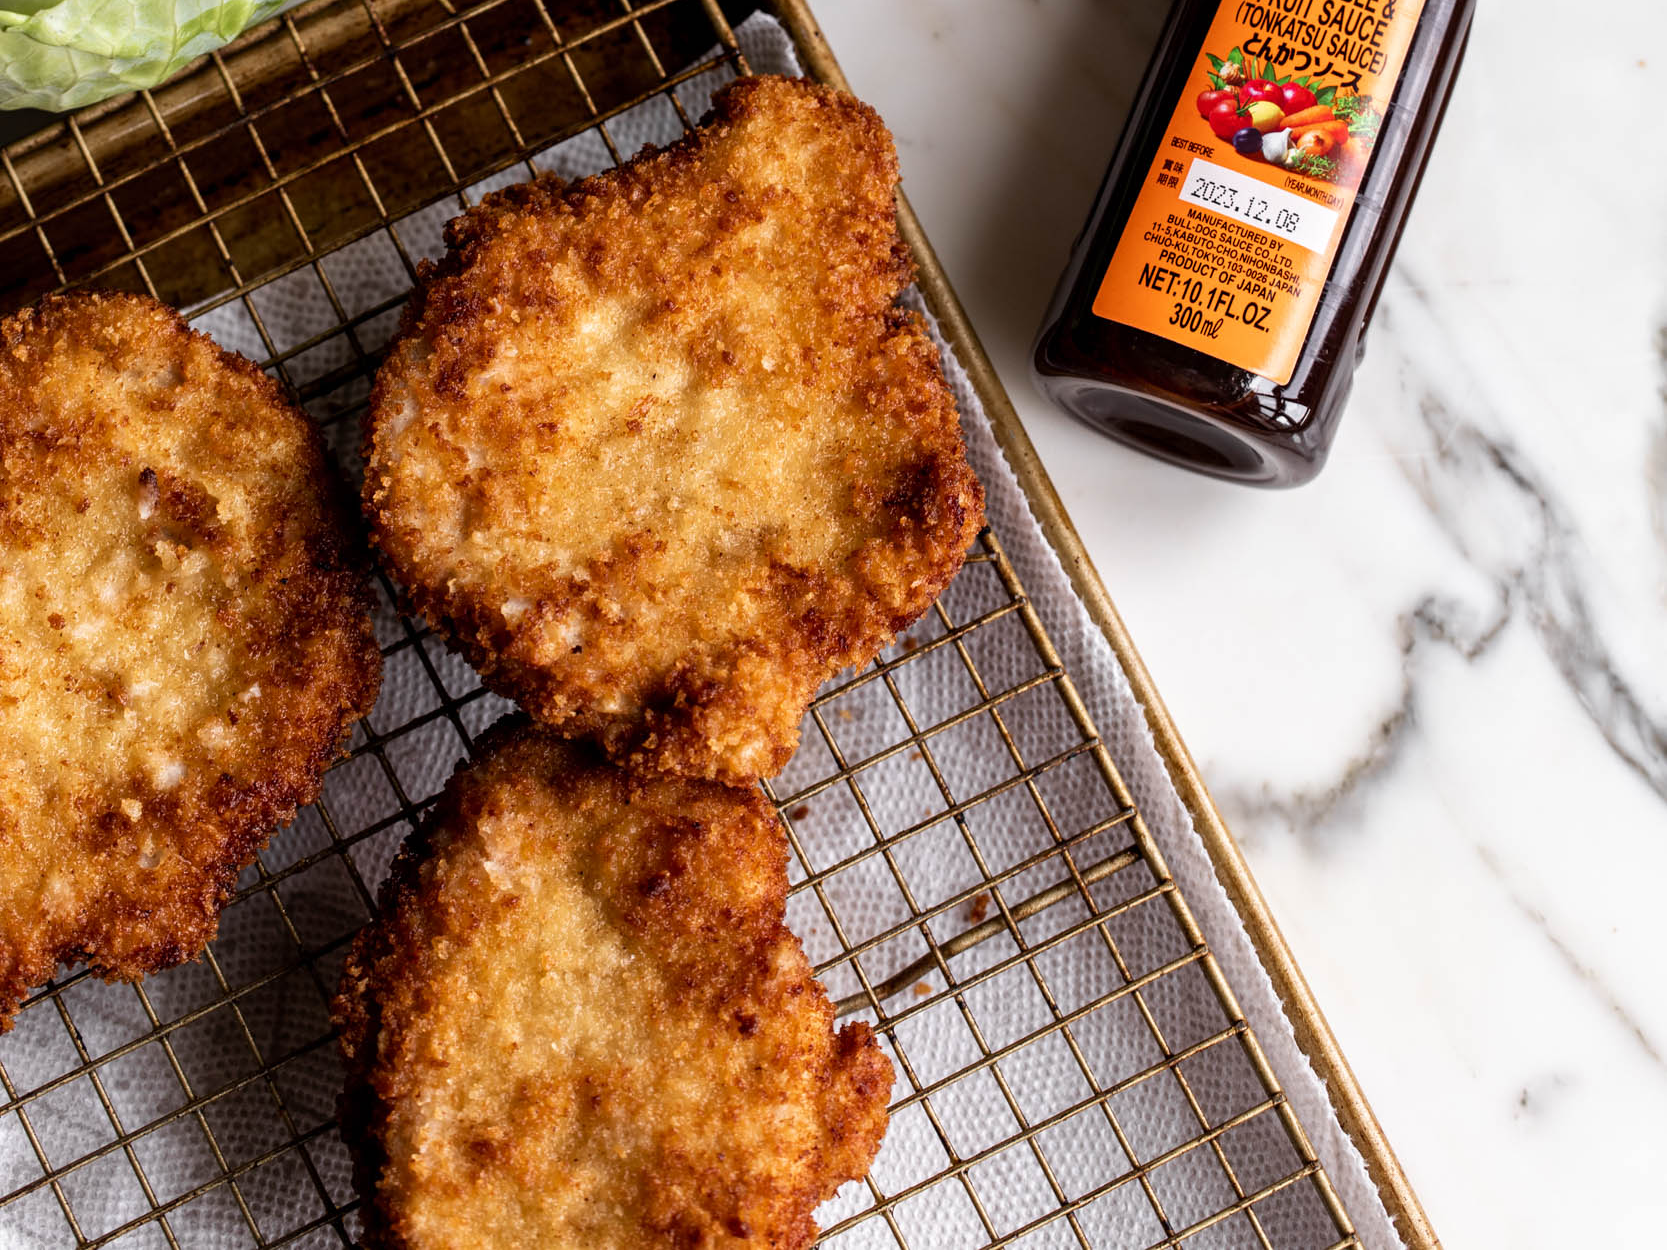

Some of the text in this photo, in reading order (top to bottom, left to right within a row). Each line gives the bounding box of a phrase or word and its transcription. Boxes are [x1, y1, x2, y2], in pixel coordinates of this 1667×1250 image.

[1235, 1, 1388, 76] (TONKATSU SAUCE)
[1318, 0, 1388, 47] SAUCE
[1243, 32, 1362, 92] とんかつソース
[1162, 158, 1185, 174] 賞味
[1171, 136, 1215, 159] BEST BEFORE
[1156, 172, 1180, 189] 期限
[1190, 178, 1300, 233] 2023.12.08
[1167, 214, 1294, 270] BULL-DOG SAUCE CO.,LTD.
[1187, 208, 1285, 252] MANUFACTURED BY
[1159, 249, 1277, 303] PRODUCT OF JAPAN
[1269, 278, 1302, 298] JAPAN
